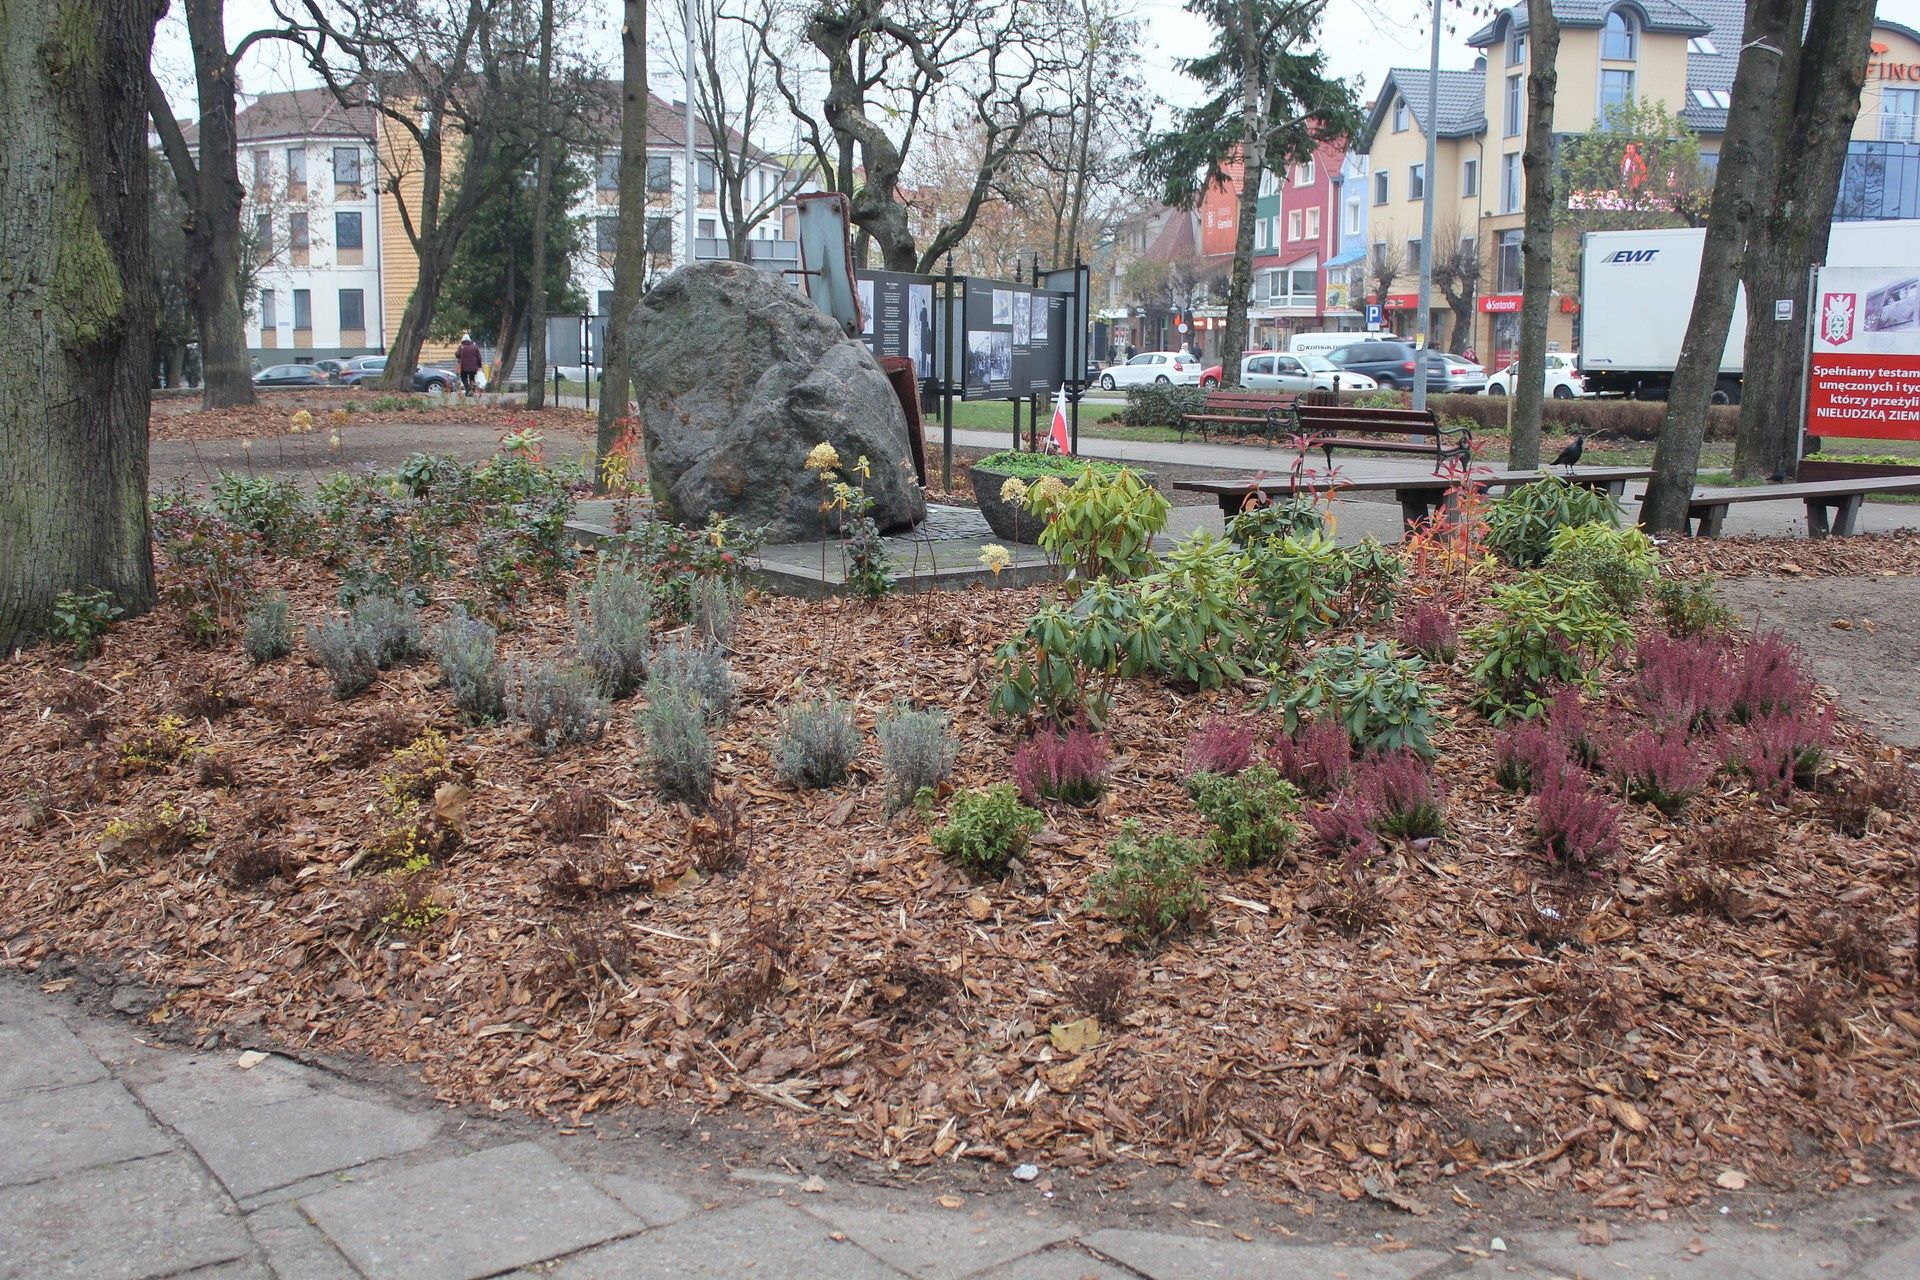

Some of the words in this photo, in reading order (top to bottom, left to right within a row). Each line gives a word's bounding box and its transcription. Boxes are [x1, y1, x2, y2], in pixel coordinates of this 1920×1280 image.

[1612, 249, 1660, 262] EWT
[1491, 300, 1517, 310] Santander
[1369, 306, 1378, 321] P
[1813, 365, 1875, 378] Spełniamy
[1878, 368, 1920, 378] testam
[1819, 381, 1893, 393] umęczonych
[1896, 382, 1900, 392] i
[1902, 383, 1920, 394] tyc
[1830, 394, 1868, 407] którzy
[1871, 396, 1919, 409] przeżyli
[1817, 407, 1886, 422] NIELUDZKĄ
[1888, 410, 1920, 421] ZIEM
